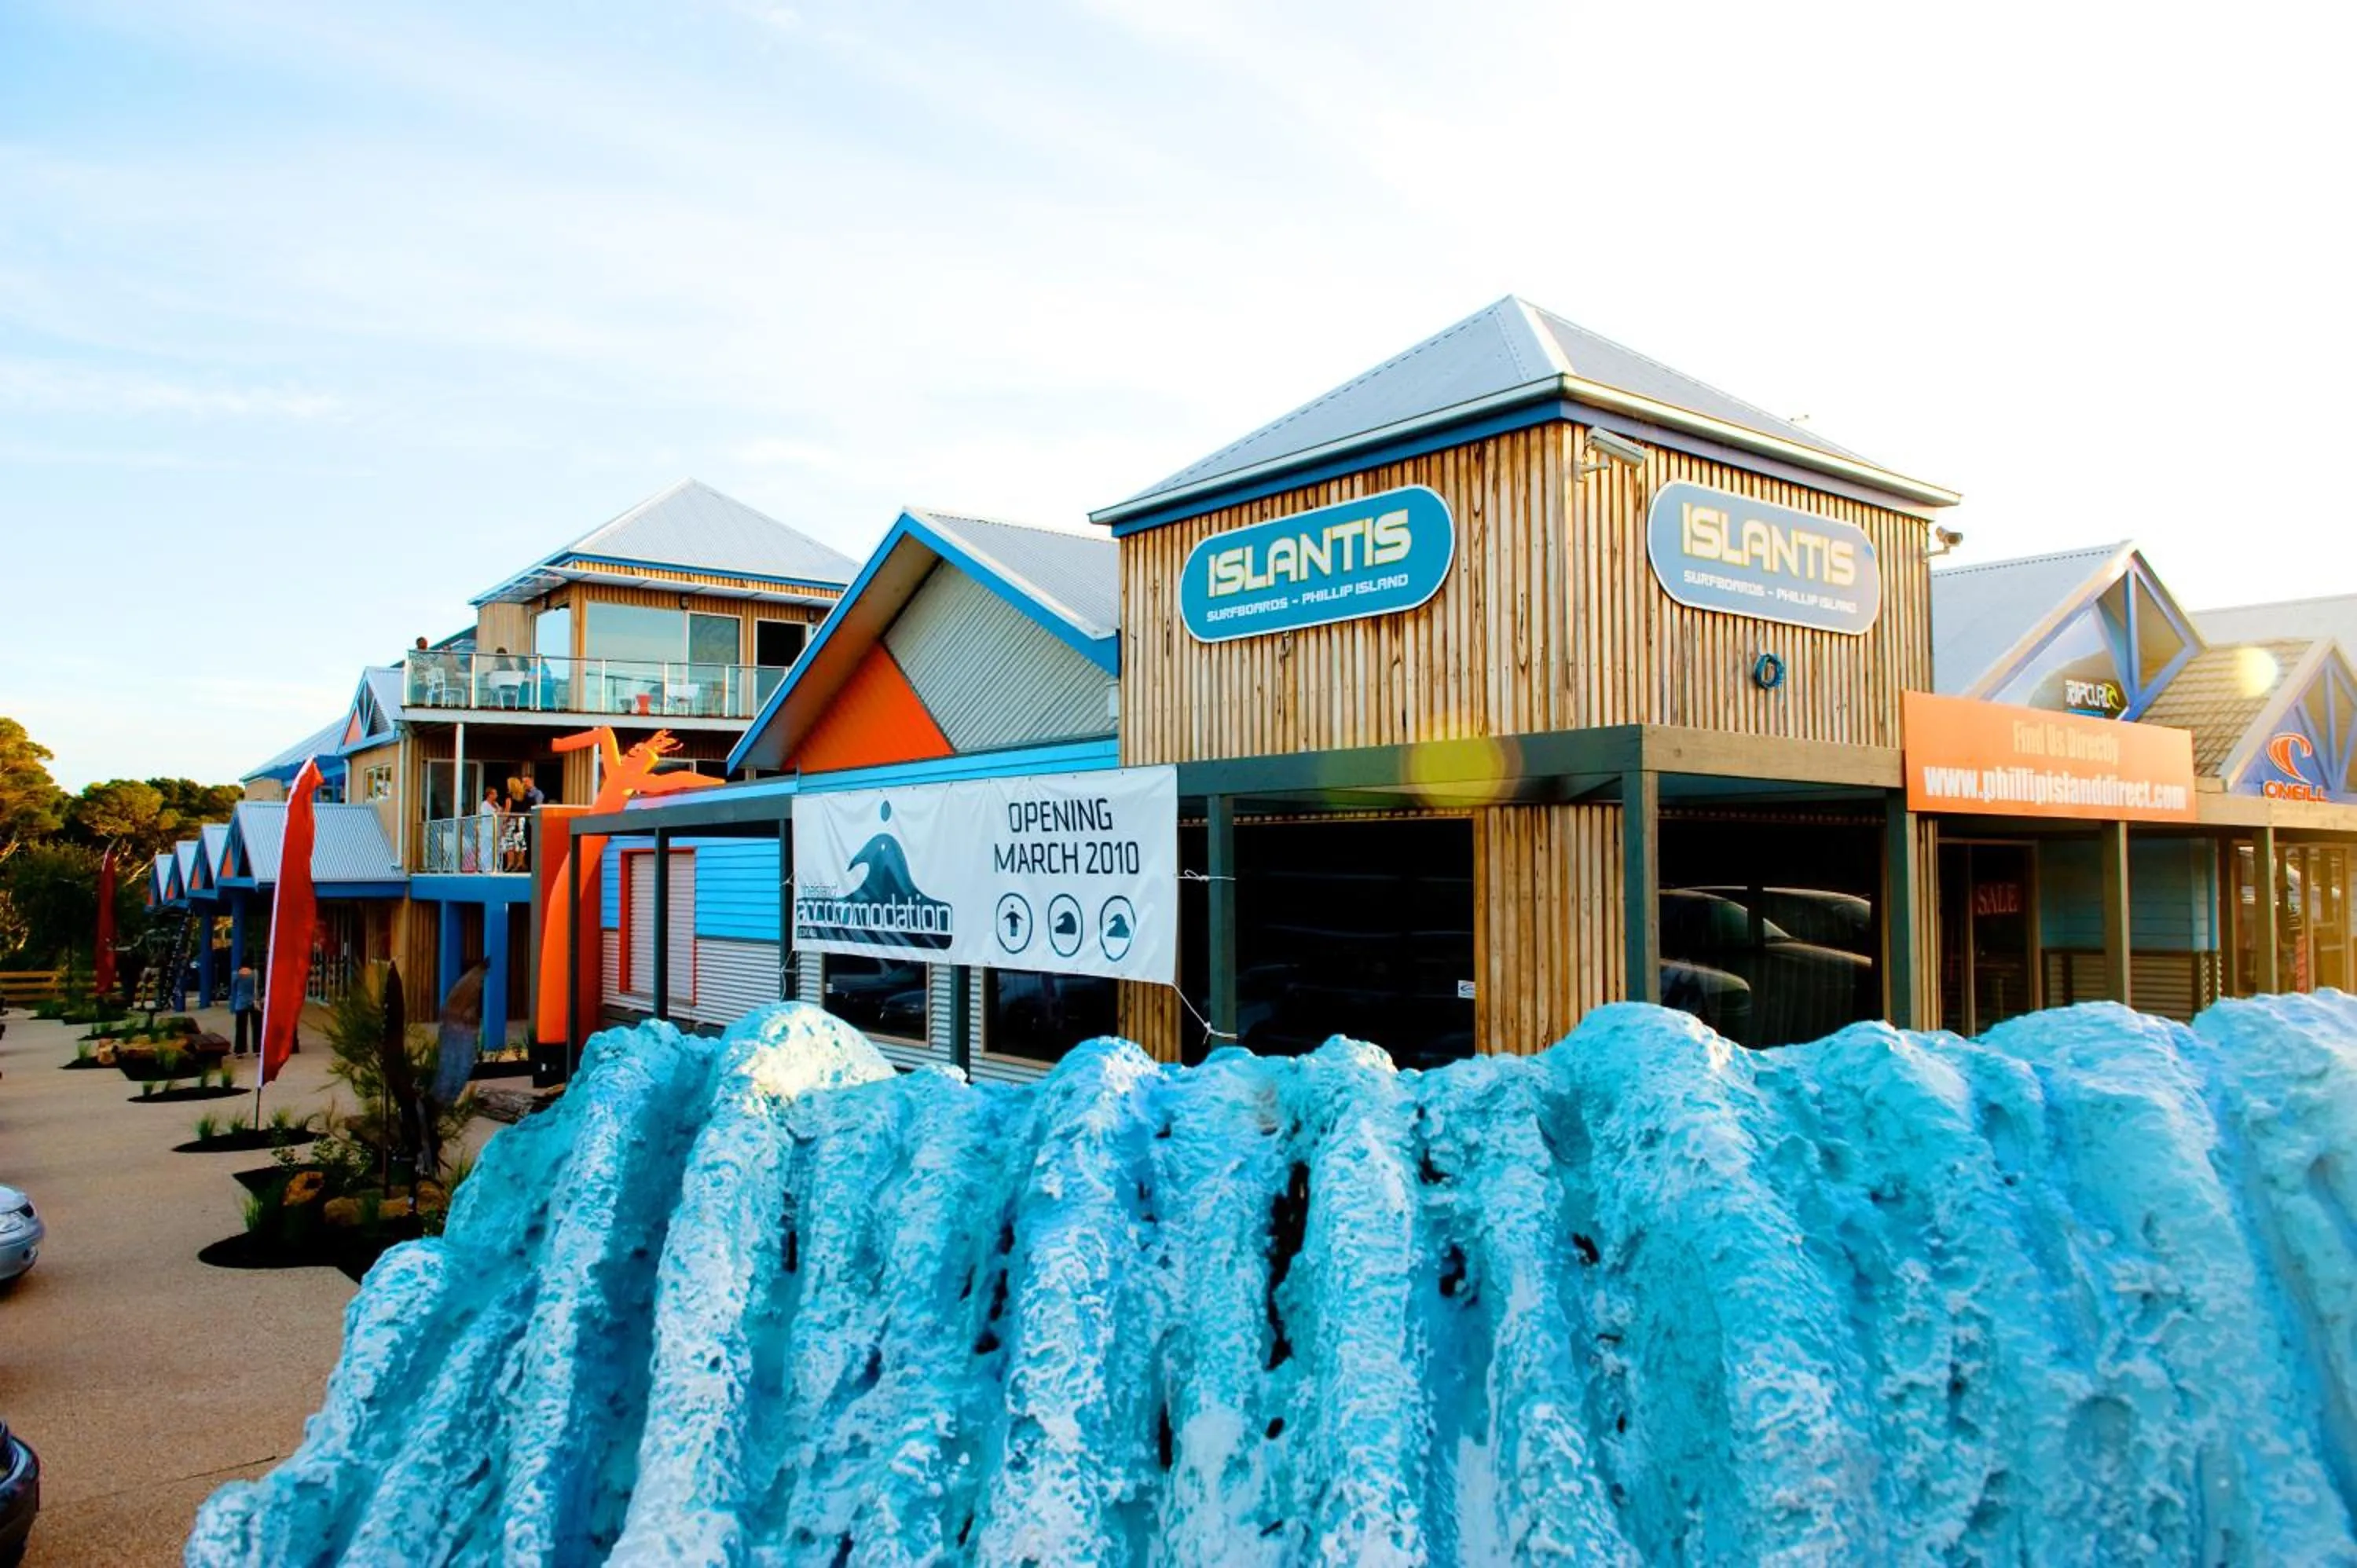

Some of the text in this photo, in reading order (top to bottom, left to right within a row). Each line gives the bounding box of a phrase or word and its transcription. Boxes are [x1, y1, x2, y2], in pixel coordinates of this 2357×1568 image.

[1207, 509, 1413, 598] ISLANTIS
[1681, 502, 1856, 586] ISLANTIS
[1207, 597, 1288, 622] SURFBOARDS
[1302, 585, 1353, 605] PHILLIP
[1355, 573, 1409, 595] ISLAND
[1684, 570, 1765, 597] SURFBOARDS
[1776, 588, 1819, 609] PHILLIP
[2013, 720, 2120, 766] Find Us Directly
[1923, 766, 2187, 810] www.phillipislanddirect.com
[1008, 798, 1113, 833] OPENING
[994, 841, 1139, 875] MARCH 2010
[797, 893, 952, 932] accommodation
[1978, 884, 2018, 915] SALE
